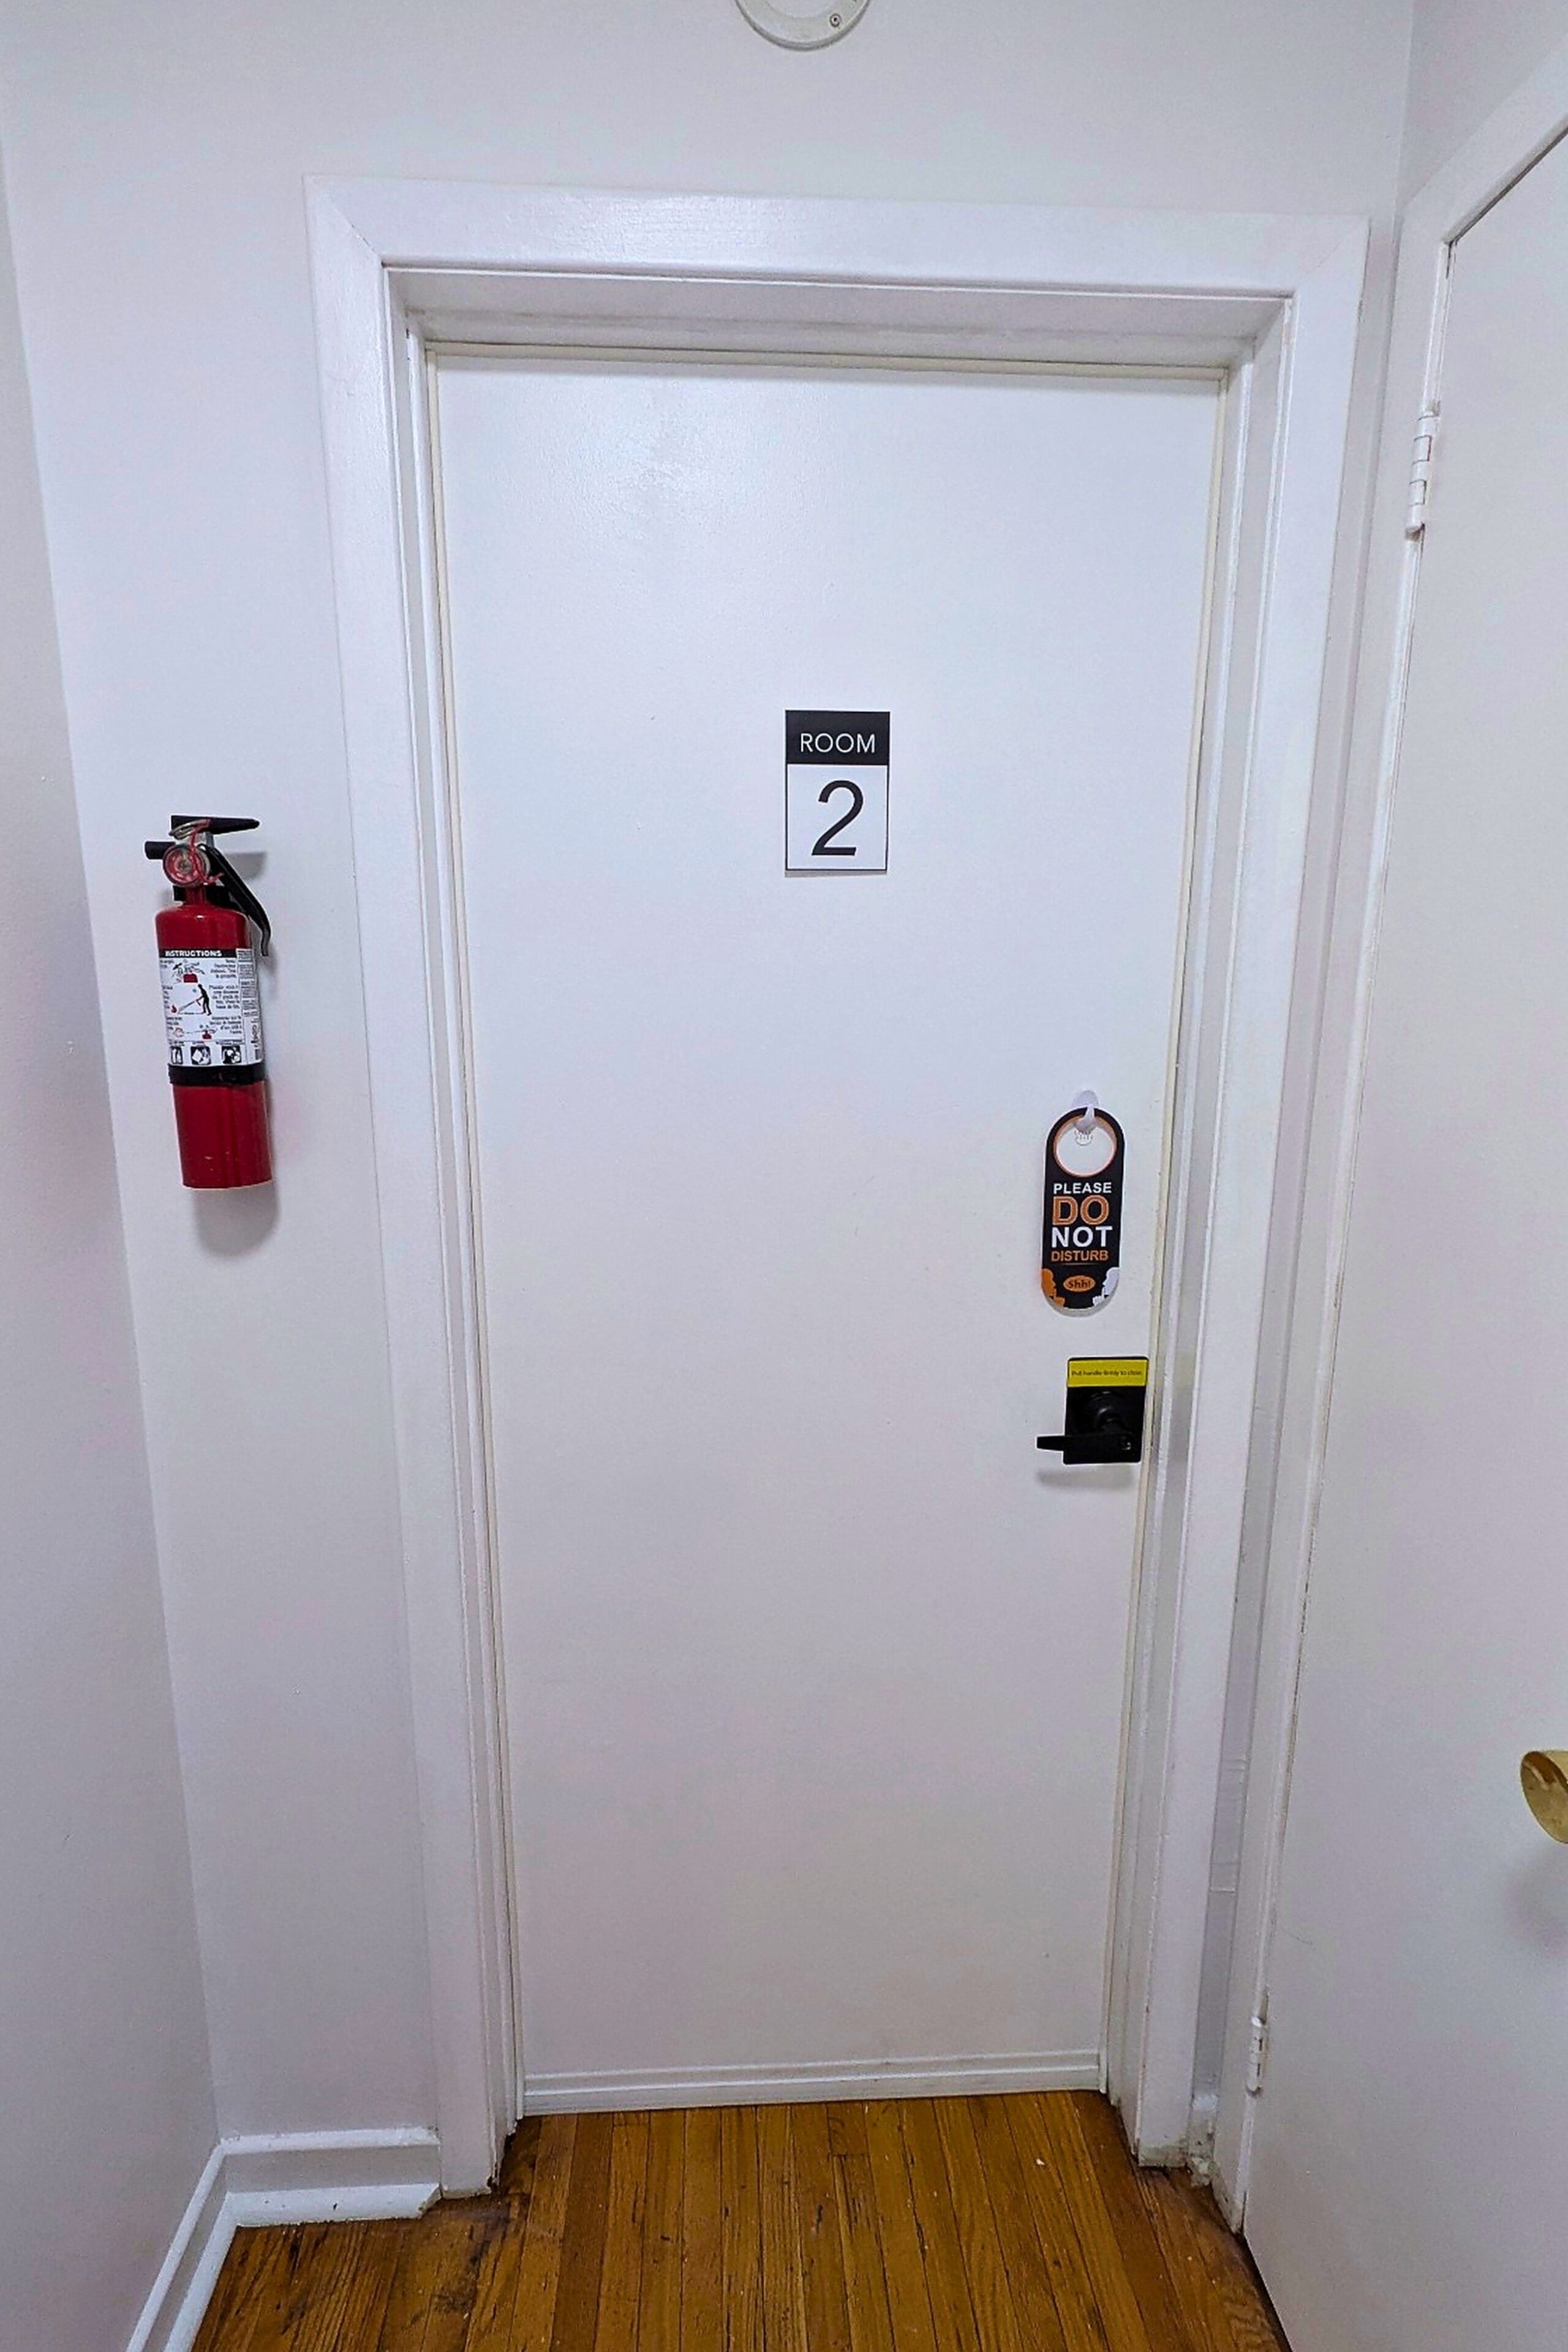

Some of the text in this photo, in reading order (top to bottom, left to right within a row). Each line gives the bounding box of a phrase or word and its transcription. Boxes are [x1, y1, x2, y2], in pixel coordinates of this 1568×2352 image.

[801, 733, 875, 753] ROOM
[812, 780, 864, 856] 2
[1053, 1182, 1112, 1194] PLEASE
[1052, 1195, 1109, 1225] DO
[1052, 1226, 1112, 1248] NOT
[1051, 1250, 1109, 1261] DISTURB
